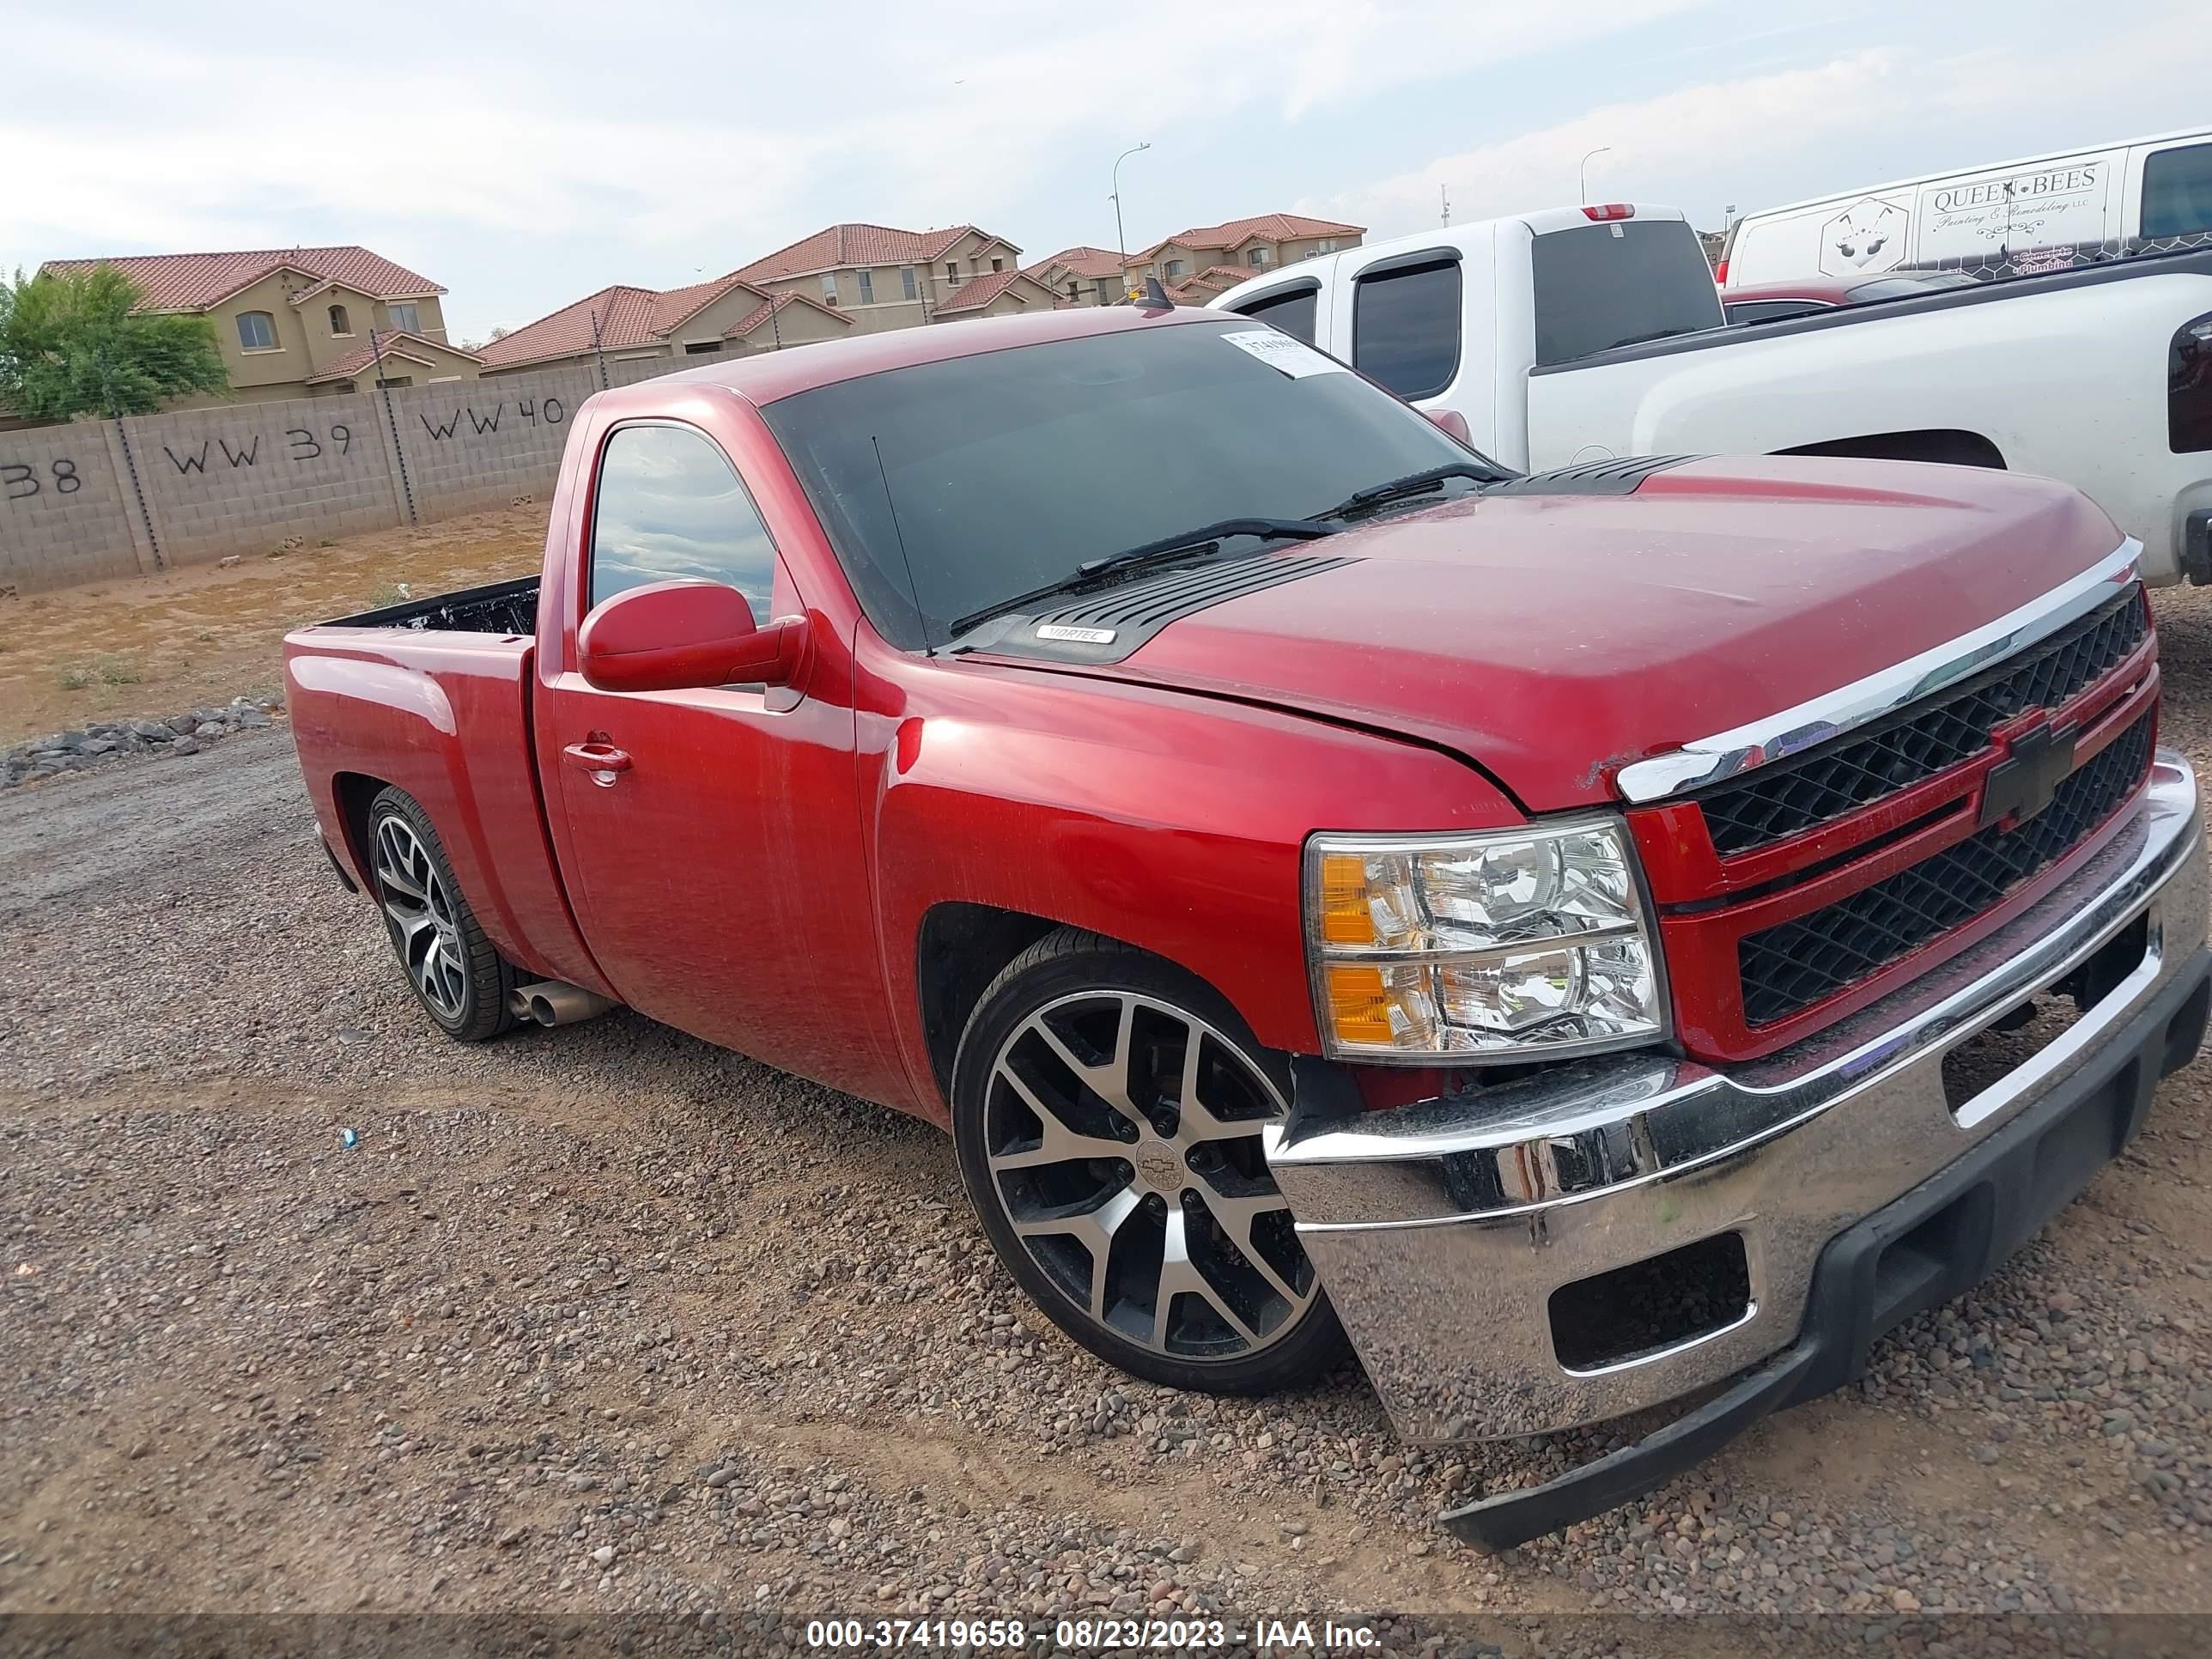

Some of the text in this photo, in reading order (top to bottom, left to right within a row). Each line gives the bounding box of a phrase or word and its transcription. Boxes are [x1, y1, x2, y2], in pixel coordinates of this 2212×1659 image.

[1935, 168, 2095, 213] QUEEN BEES
[1936, 199, 2088, 228] Painting & Remodeling LLC
[2019, 246, 2074, 262] Concrete
[518, 398, 563, 427] 40
[284, 425, 350, 460] 39
[0, 459, 81, 500] 38
[1049, 627, 1104, 641] VORTEC
